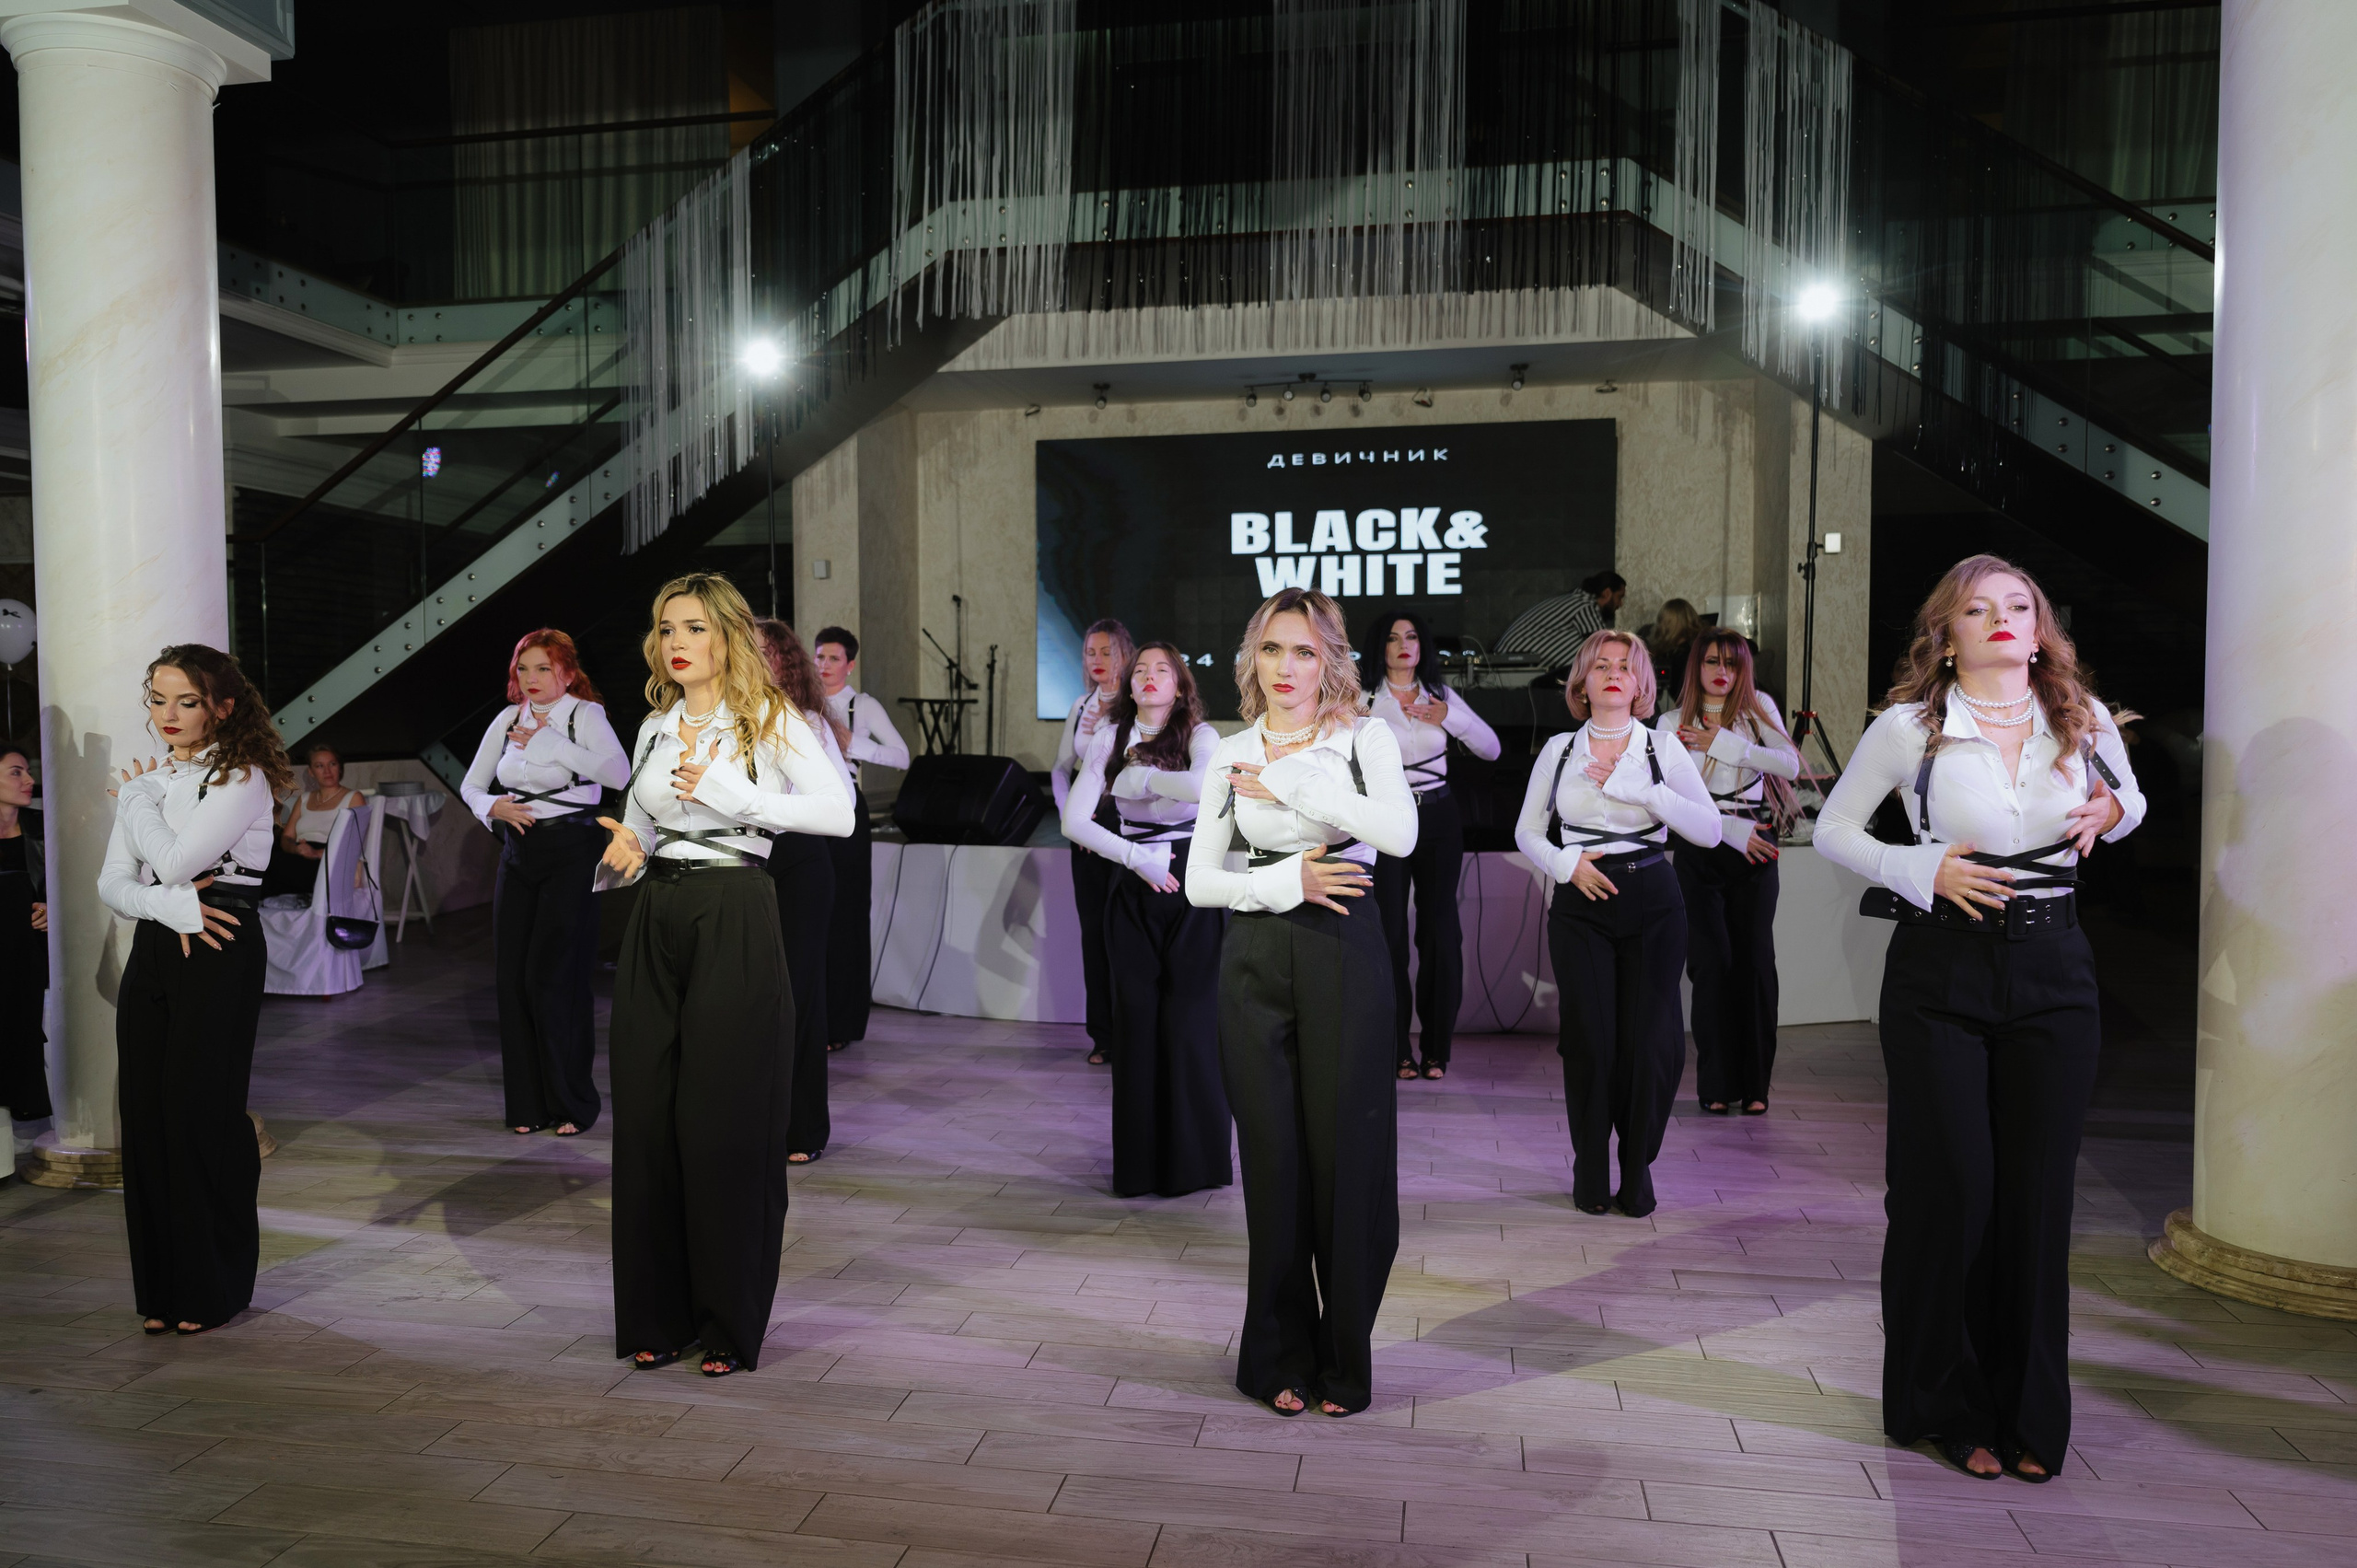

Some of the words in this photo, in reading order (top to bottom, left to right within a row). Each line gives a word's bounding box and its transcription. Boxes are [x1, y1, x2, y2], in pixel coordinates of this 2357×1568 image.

[1267, 448, 1448, 470] ДЕВИЧНИК
[1231, 507, 1489, 554] BLACK&
[1255, 552, 1462, 598] WHITE
